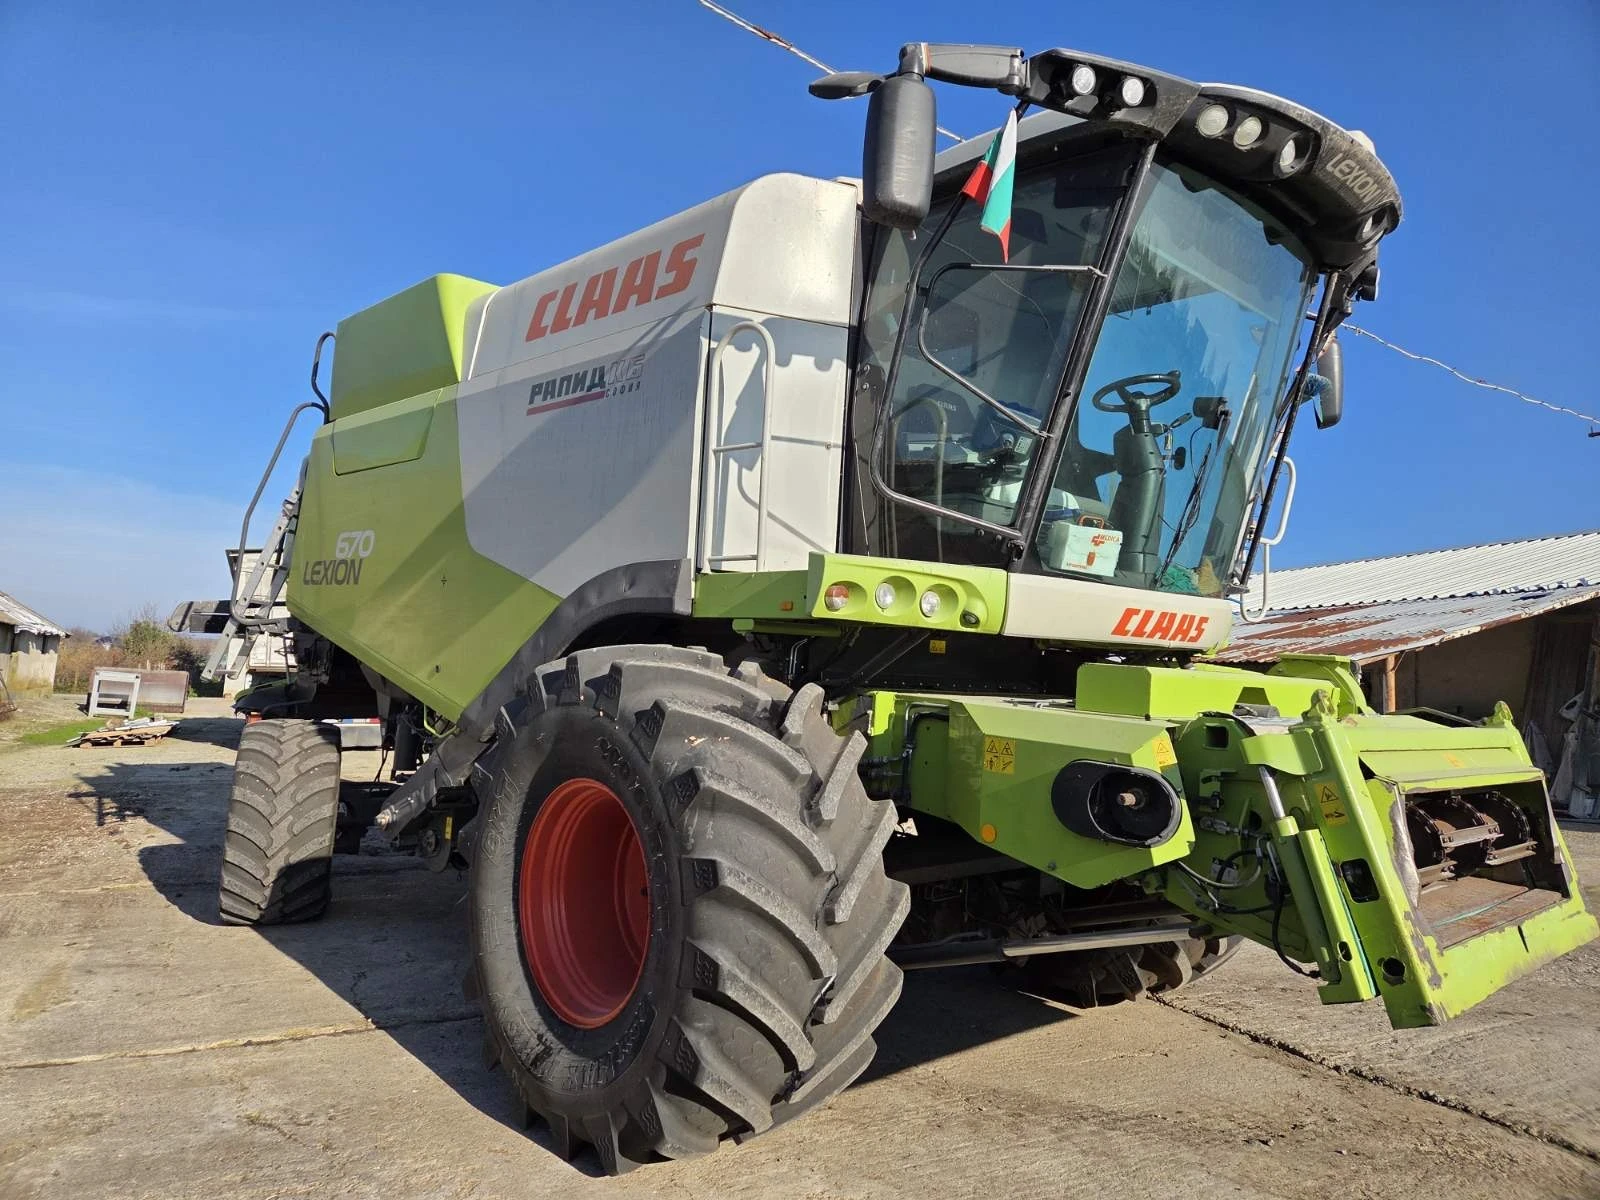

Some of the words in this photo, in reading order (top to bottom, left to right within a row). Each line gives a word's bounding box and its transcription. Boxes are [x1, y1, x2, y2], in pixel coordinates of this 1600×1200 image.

[1325, 152, 1382, 203] LEXION
[525, 233, 705, 342] CLAAS
[527, 364, 606, 405] РАПИД
[335, 529, 375, 559] 670
[303, 559, 363, 586] LEXION
[1110, 607, 1210, 643] CLAAS
